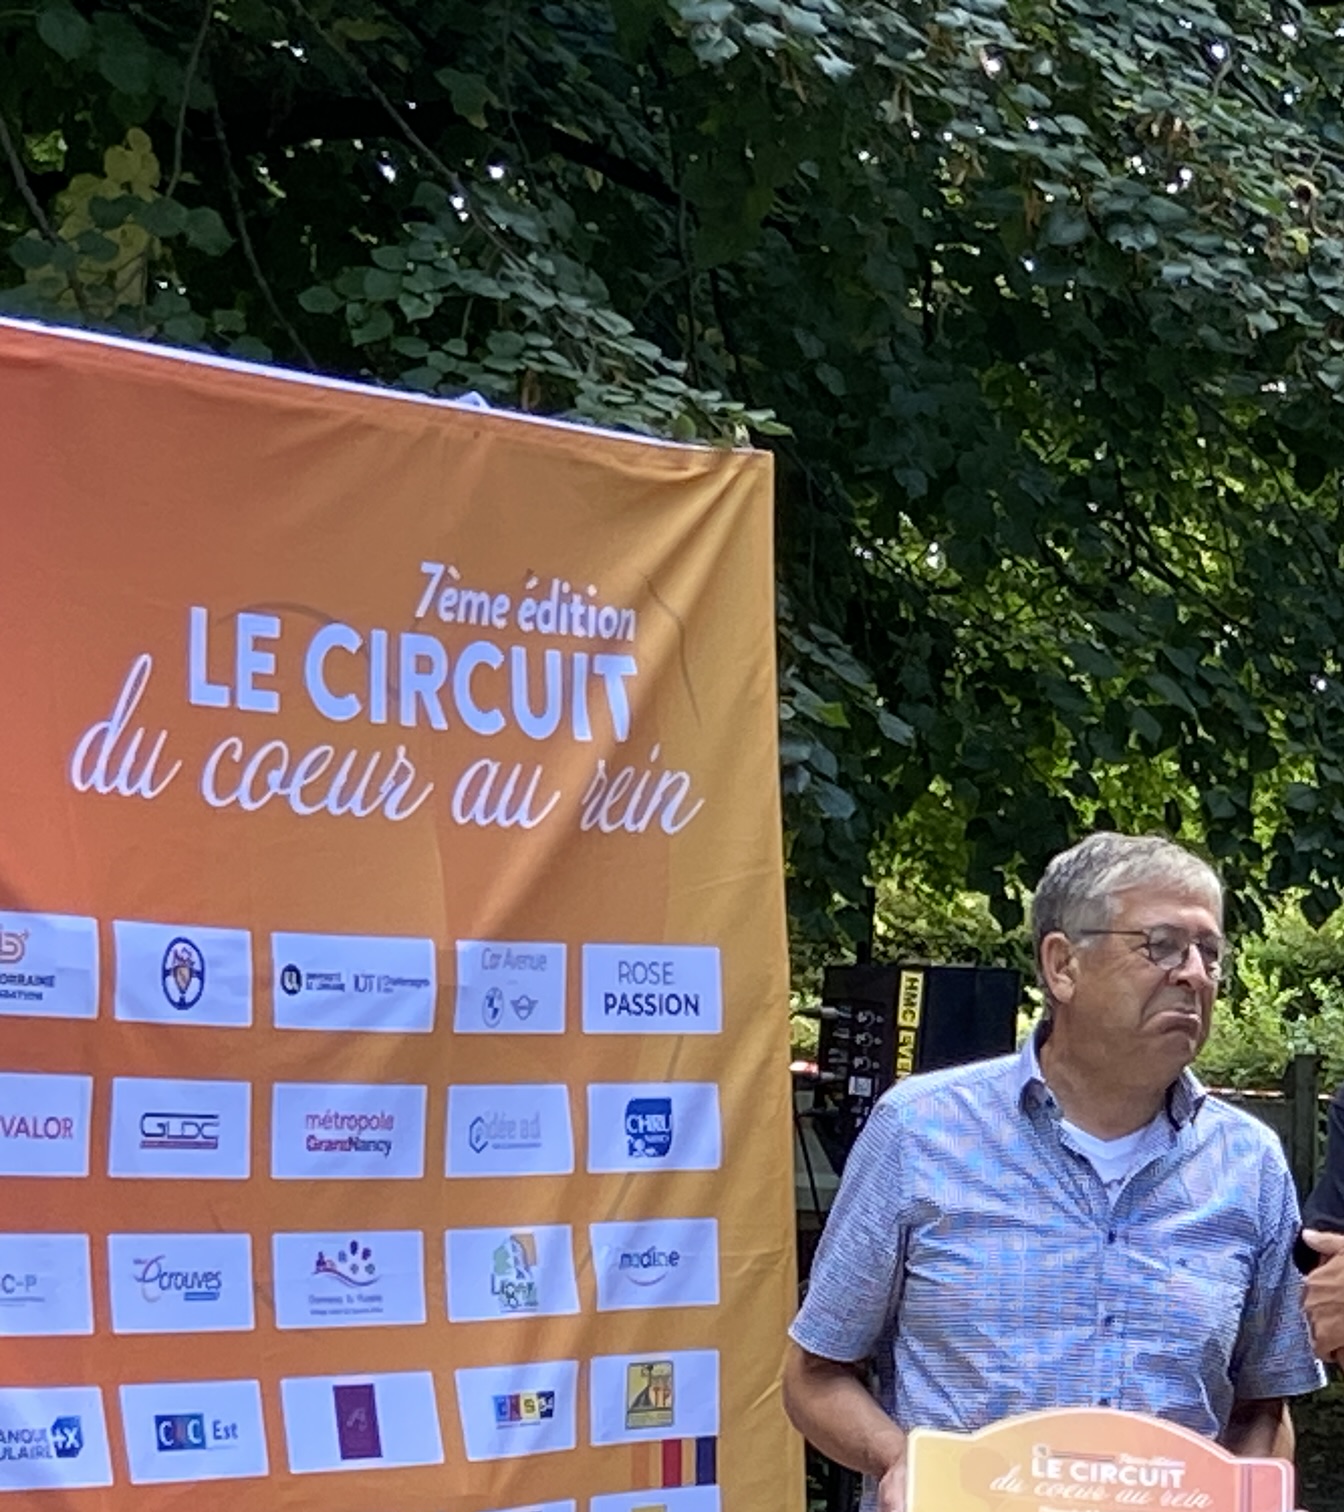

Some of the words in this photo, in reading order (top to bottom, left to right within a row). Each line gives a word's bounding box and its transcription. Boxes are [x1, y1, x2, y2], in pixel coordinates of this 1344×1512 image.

[415, 561, 508, 629] 7ème
[517, 572, 637, 642] édition
[189, 606, 280, 713] LE
[304, 622, 638, 742] CIRCUIT
[70, 654, 183, 799] du
[200, 735, 434, 821] coeur
[451, 757, 561, 831] au
[580, 742, 705, 835] rein
[618, 961, 674, 986] ROSE
[604, 992, 700, 1017] PASSION
[305, 1109, 394, 1135] métropole
[212, 1419, 238, 1442] Est
[989, 1464, 1024, 1493] du
[1114, 1486, 1152, 1505] au
[1031, 1459, 1061, 1480] LE
[1070, 1461, 1186, 1489] CIRCUIT
